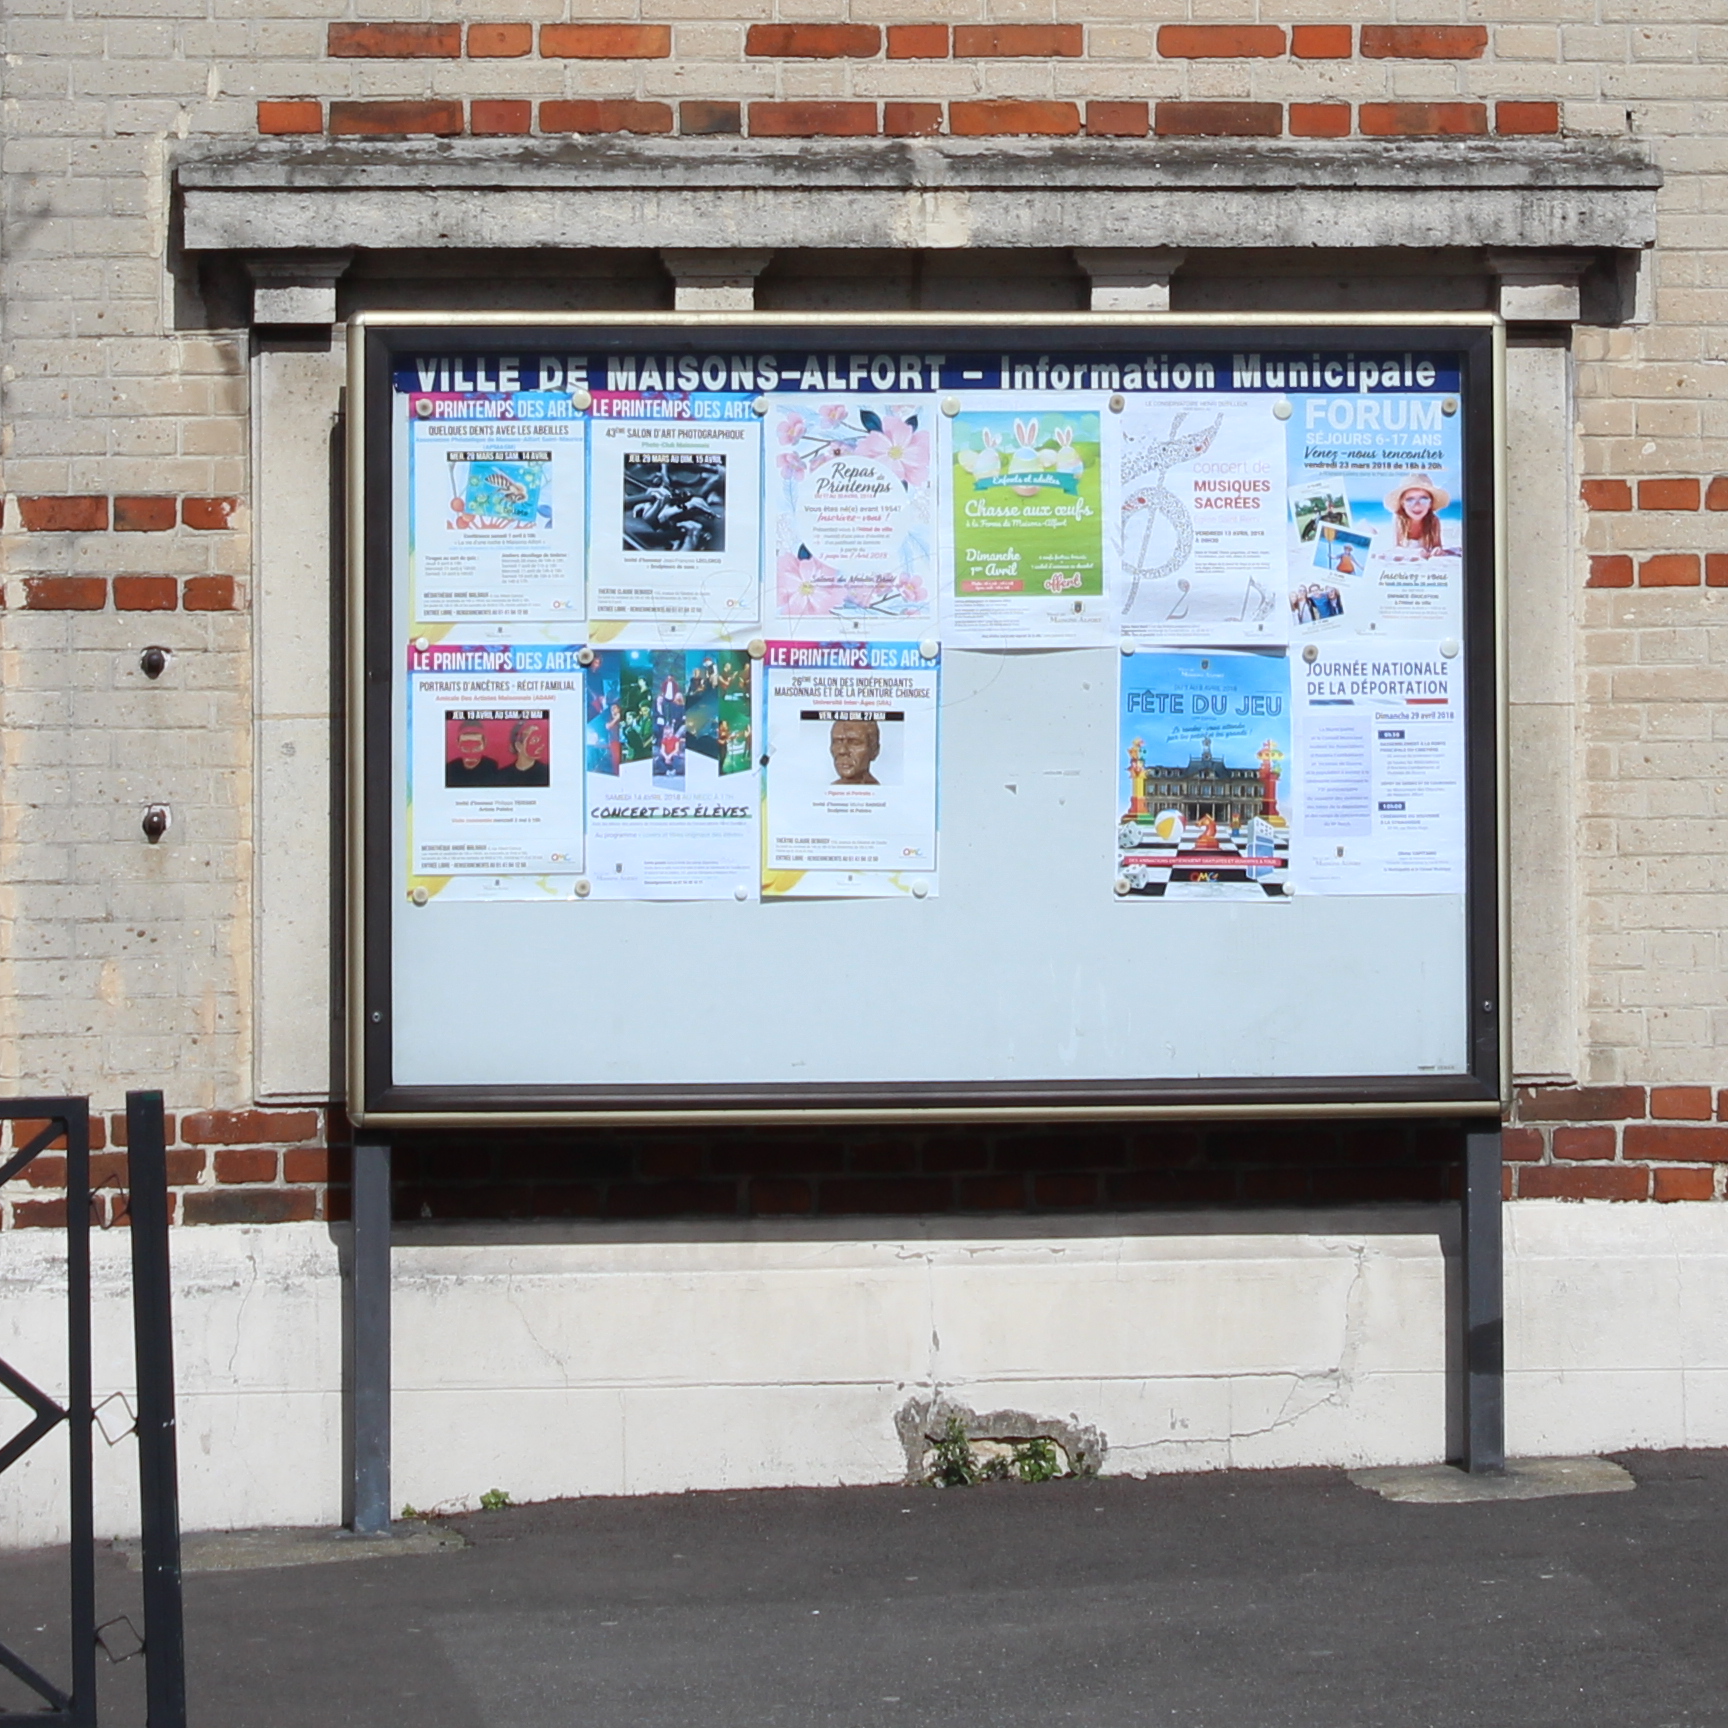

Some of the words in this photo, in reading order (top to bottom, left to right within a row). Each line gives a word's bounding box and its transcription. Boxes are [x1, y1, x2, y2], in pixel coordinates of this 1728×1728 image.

[415, 357, 520, 392] VILLE
[539, 356, 588, 390] DE
[606, 355, 945, 391] MAISONS-ALFORT
[1001, 354, 1215, 390] Information
[1233, 354, 1437, 394] Municipale
[435, 400, 514, 418] PRINTEMPS
[518, 400, 543, 418] DES
[547, 400, 583, 418] ART
[592, 399, 610, 417] LE
[613, 399, 691, 418] PRINTEMPS
[694, 400, 721, 418] DES
[1305, 398, 1443, 431] FORUM
[428, 425, 467, 436] QUELQUES
[469, 425, 494, 436] DENTS
[496, 425, 516, 436] AVEC
[517, 425, 531, 436] LES
[533, 425, 569, 436] ABEILLES
[627, 428, 652, 438] SALON
[653, 428, 675, 439] D'ART
[677, 429, 745, 440] PHOTOGRAPHIQUE
[1305, 432, 1372, 445] SÉJOURS
[1375, 433, 1408, 446] 6-17
[1412, 434, 1442, 446] ANS
[671, 454, 679, 463] AU
[1382, 448, 1444, 460] rencontrer
[832, 462, 876, 482] Repas
[1193, 461, 1248, 474] concert
[1252, 461, 1270, 474] de
[1304, 461, 1337, 469] vendredi
[1339, 461, 1349, 469] 23
[1351, 461, 1370, 469] mars
[1372, 461, 1391, 469] 2018
[1393, 461, 1404, 469] de
[1428, 461, 1442, 469] 20h
[1023, 474, 1031, 483] et
[1033, 474, 1060, 485] adultes
[1193, 479, 1270, 494] MUSIQUES
[816, 477, 892, 497] Printemps
[965, 498, 1020, 517] Chasse
[1023, 505, 1052, 517] aux
[1055, 497, 1093, 521] œufs
[1194, 495, 1260, 509] SACRÉES
[804, 505, 822, 513] Vous
[839, 505, 858, 514] né(e)
[860, 505, 879, 513] avant
[966, 547, 1021, 562] Dimanche
[985, 562, 1017, 576] Avril
[1045, 572, 1081, 592] offert
[413, 652, 430, 670] LE
[434, 652, 513, 670] PRINTEMPS
[516, 652, 542, 670] DES
[770, 648, 787, 665] LE
[790, 648, 868, 666] PRINTEMPS
[872, 649, 897, 666] DES
[1306, 660, 1367, 677] JOURNÉE
[1372, 662, 1448, 676] NATIONALE
[419, 681, 461, 692] PORTRAITS
[463, 679, 510, 691] D'ANCÊTRES
[516, 679, 538, 691] RÉCIT
[541, 681, 575, 691] FAMILIAL
[813, 677, 838, 687] SALON
[839, 677, 854, 687] DES
[856, 676, 913, 687] INDÉPENDANTS
[1307, 681, 1324, 695] DE
[1329, 681, 1346, 695] LA
[1351, 679, 1448, 695] DÉPORTATION
[774, 687, 821, 698] MAISONNAIS
[823, 687, 832, 698] ET
[834, 687, 843, 698] DE
[846, 687, 855, 698] LA
[858, 687, 893, 698] PEINTURE
[895, 687, 930, 698] CHINOISE
[1127, 689, 1184, 713] FÊTE
[1192, 695, 1227, 715] DU
[1235, 696, 1282, 716] JEU
[495, 710, 503, 720] AU
[1375, 711, 1409, 720] Dimanche
[1411, 711, 1419, 720] 29
[1421, 711, 1436, 720] avril
[1437, 711, 1454, 720] 2018
[605, 793, 632, 801] SAMEDI
[591, 807, 659, 818] CONCERT
[662, 807, 690, 818] DES
[694, 803, 749, 818] ÉLÈVES
